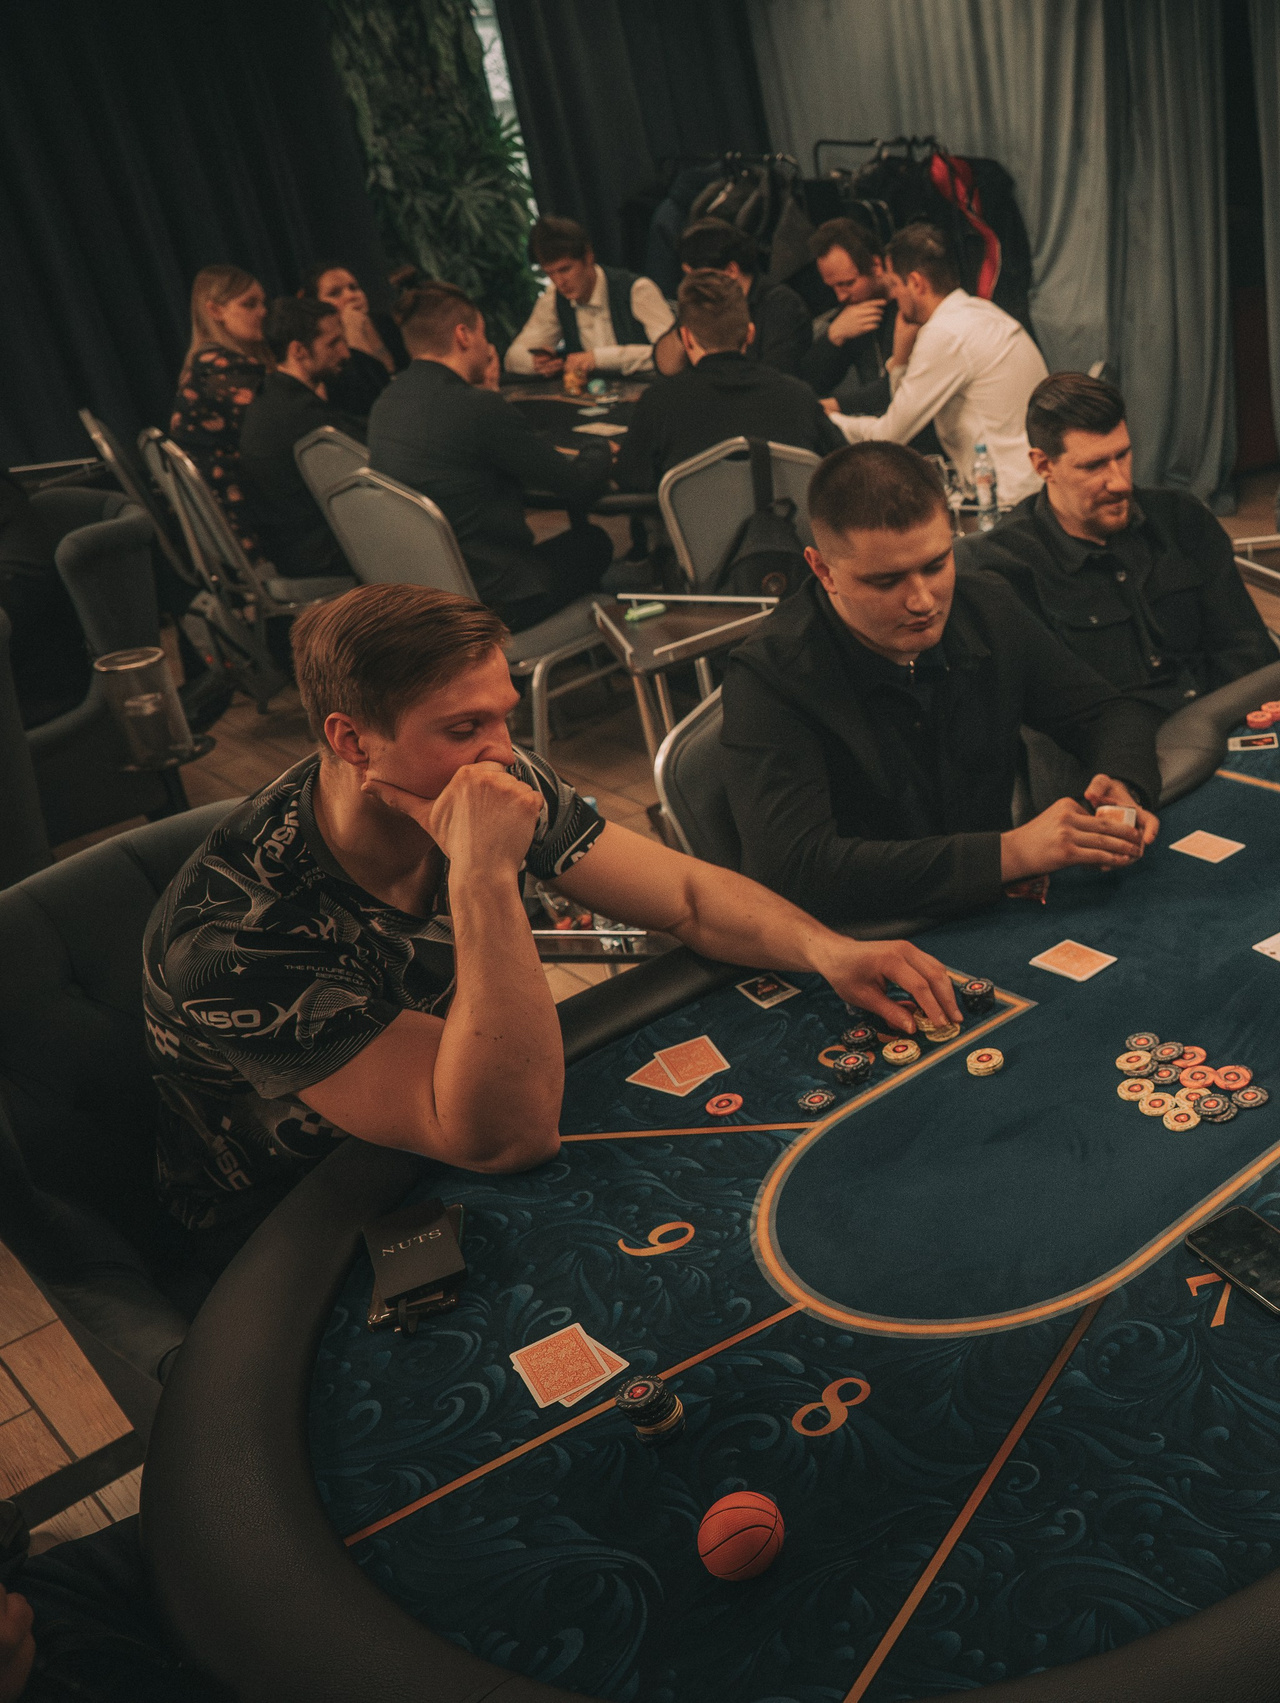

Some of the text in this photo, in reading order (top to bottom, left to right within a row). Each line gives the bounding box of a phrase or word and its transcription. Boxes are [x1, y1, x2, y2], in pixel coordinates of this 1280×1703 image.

[382, 1229, 442, 1257] NUTS
[1185, 1272, 1232, 1328] 7
[791, 1377, 871, 1437] 8
